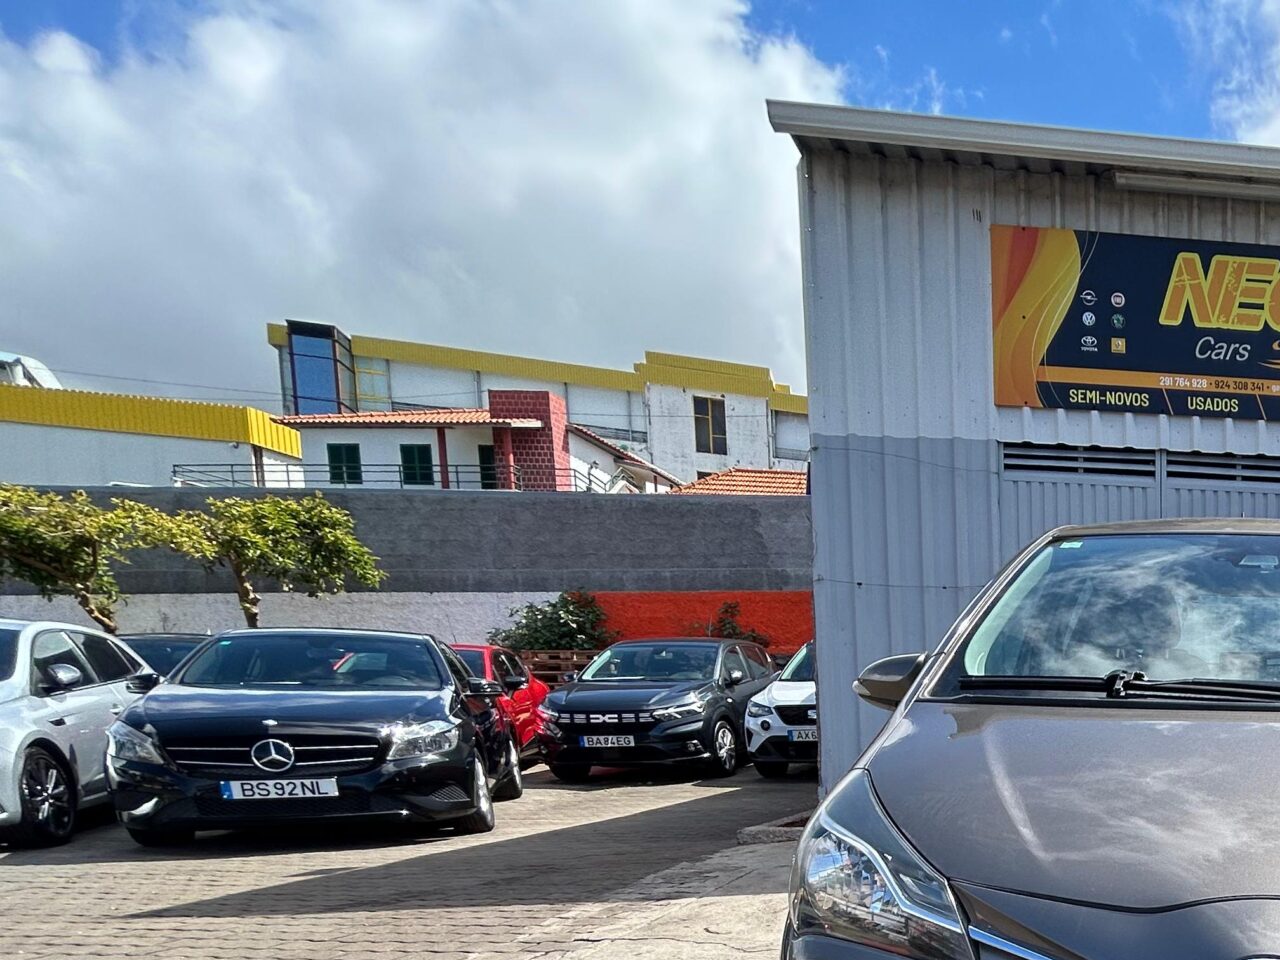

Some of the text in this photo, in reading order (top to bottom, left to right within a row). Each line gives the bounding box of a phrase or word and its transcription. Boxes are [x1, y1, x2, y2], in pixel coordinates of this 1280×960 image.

[1195, 336, 1251, 361] Cars
[1159, 376, 1173, 386] 291
[1174, 377, 1190, 387] 764
[1191, 378, 1208, 388] 928
[1214, 379, 1231, 390] 924
[1232, 381, 1249, 391] 308
[1250, 382, 1265, 392] 341
[1069, 389, 1149, 407] SEMI-NOVOS
[1187, 396, 1239, 412] USADOS
